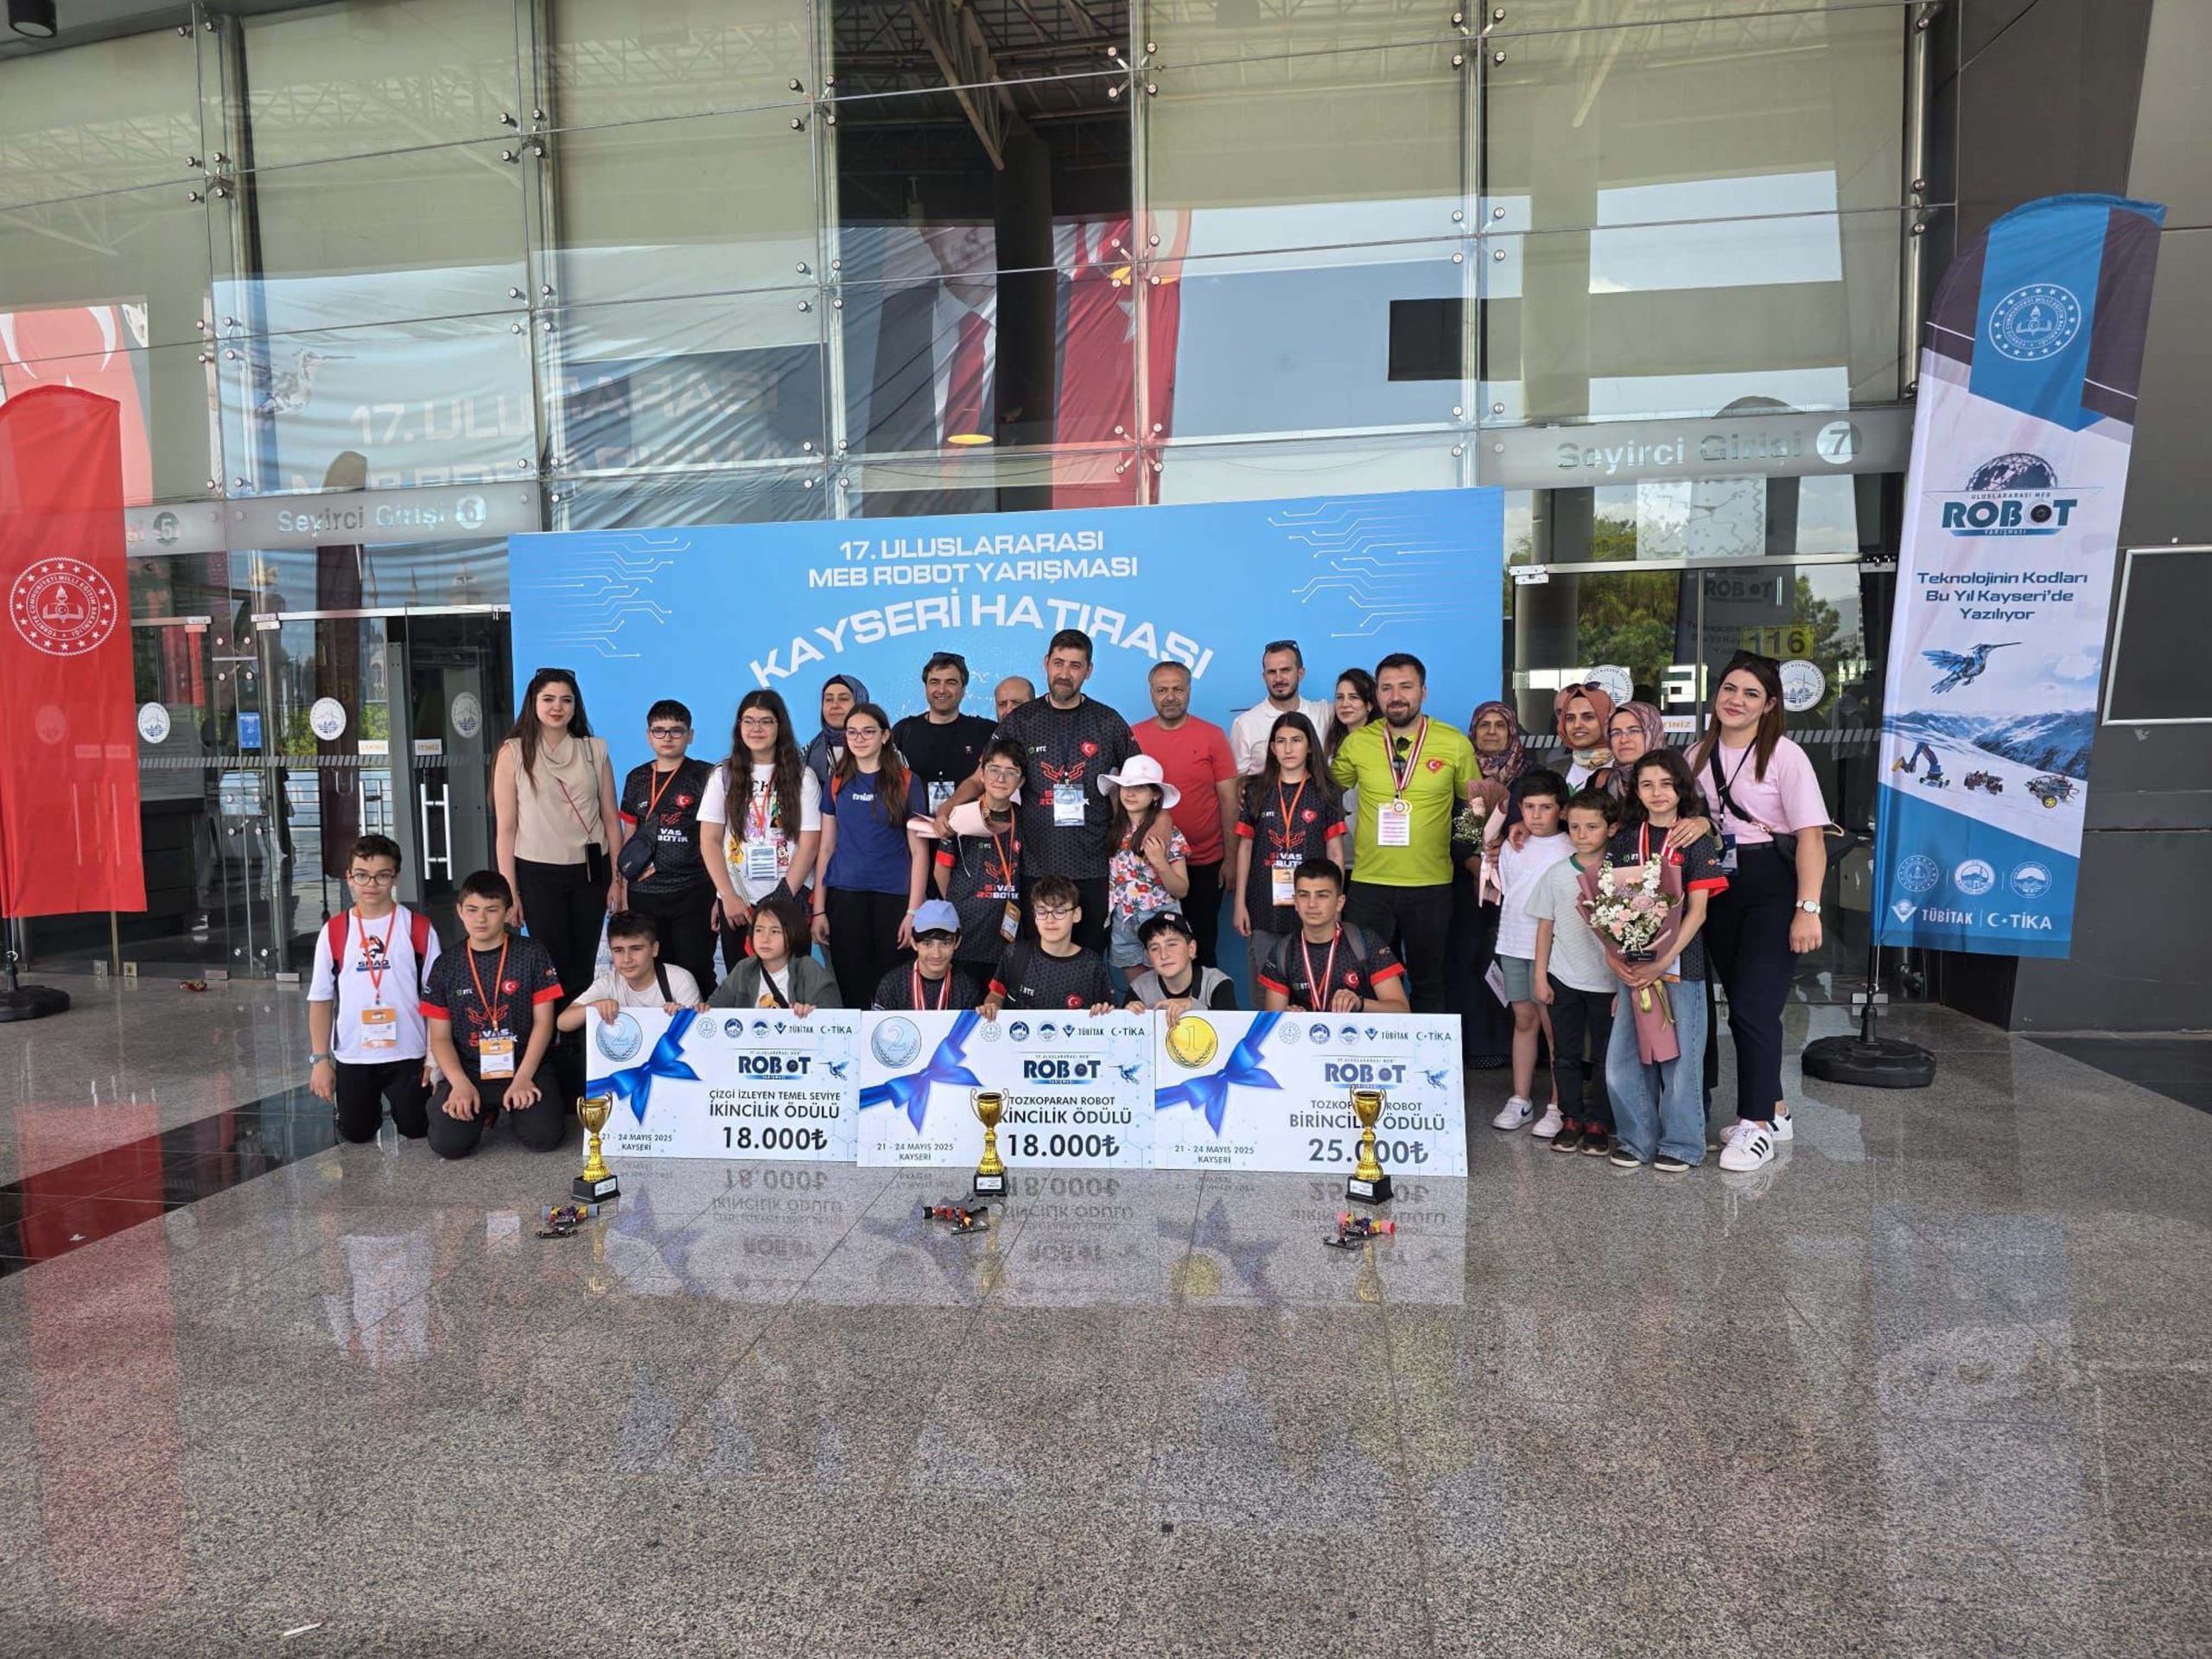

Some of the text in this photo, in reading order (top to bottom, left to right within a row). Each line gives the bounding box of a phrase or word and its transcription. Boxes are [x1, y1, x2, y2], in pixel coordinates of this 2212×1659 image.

[1556, 437, 1685, 475] Seyirci
[1700, 434, 1802, 467] Girişi
[277, 507, 365, 537] Seyirci
[377, 502, 443, 531] Girişi
[839, 531, 1104, 561] 17. ULUSLARARASI
[808, 556, 1139, 588] MEB ROBOT YARIŞMASI
[1916, 570, 2088, 587] Teknolojinin Kodları
[1925, 588, 2075, 604] Bu Yıl Kayseri'de
[1959, 607, 2036, 623] Yazılıyor
[748, 588, 1216, 689] KAYSERİ HATIRASI
[659, 828, 683, 836] VAS
[1921, 907, 1974, 925] TÜBİTAK
[709, 1090, 841, 1102] ÇİZGİ İZLEYEN TEMEL SEVİYE
[1009, 1096, 1116, 1106] TOZKOPARAN ROBOT
[709, 1101, 841, 1119] İKİNCİLİK ÖDÜLÜ
[1311, 1099, 1422, 1111] TOZKOP ROBOT
[999, 1107, 1132, 1124] KİNCİLİK ÖDÜLÜ
[1289, 1111, 1446, 1131] BİRİNCİL ÖDÜLÜ
[621, 1141, 652, 1151] KAYSERİ
[654, 1134, 672, 1142] 2025
[895, 1143, 906, 1152] 24
[907, 1143, 934, 1152] MAYIS
[935, 1143, 954, 1152] 2025
[1194, 1145, 1205, 1154] 24
[1205, 1145, 1231, 1154] MAYIS
[1233, 1146, 1255, 1155] 2025
[899, 1151, 931, 1161] KAYSERİ
[1198, 1154, 1231, 1165] KAYSERİ
